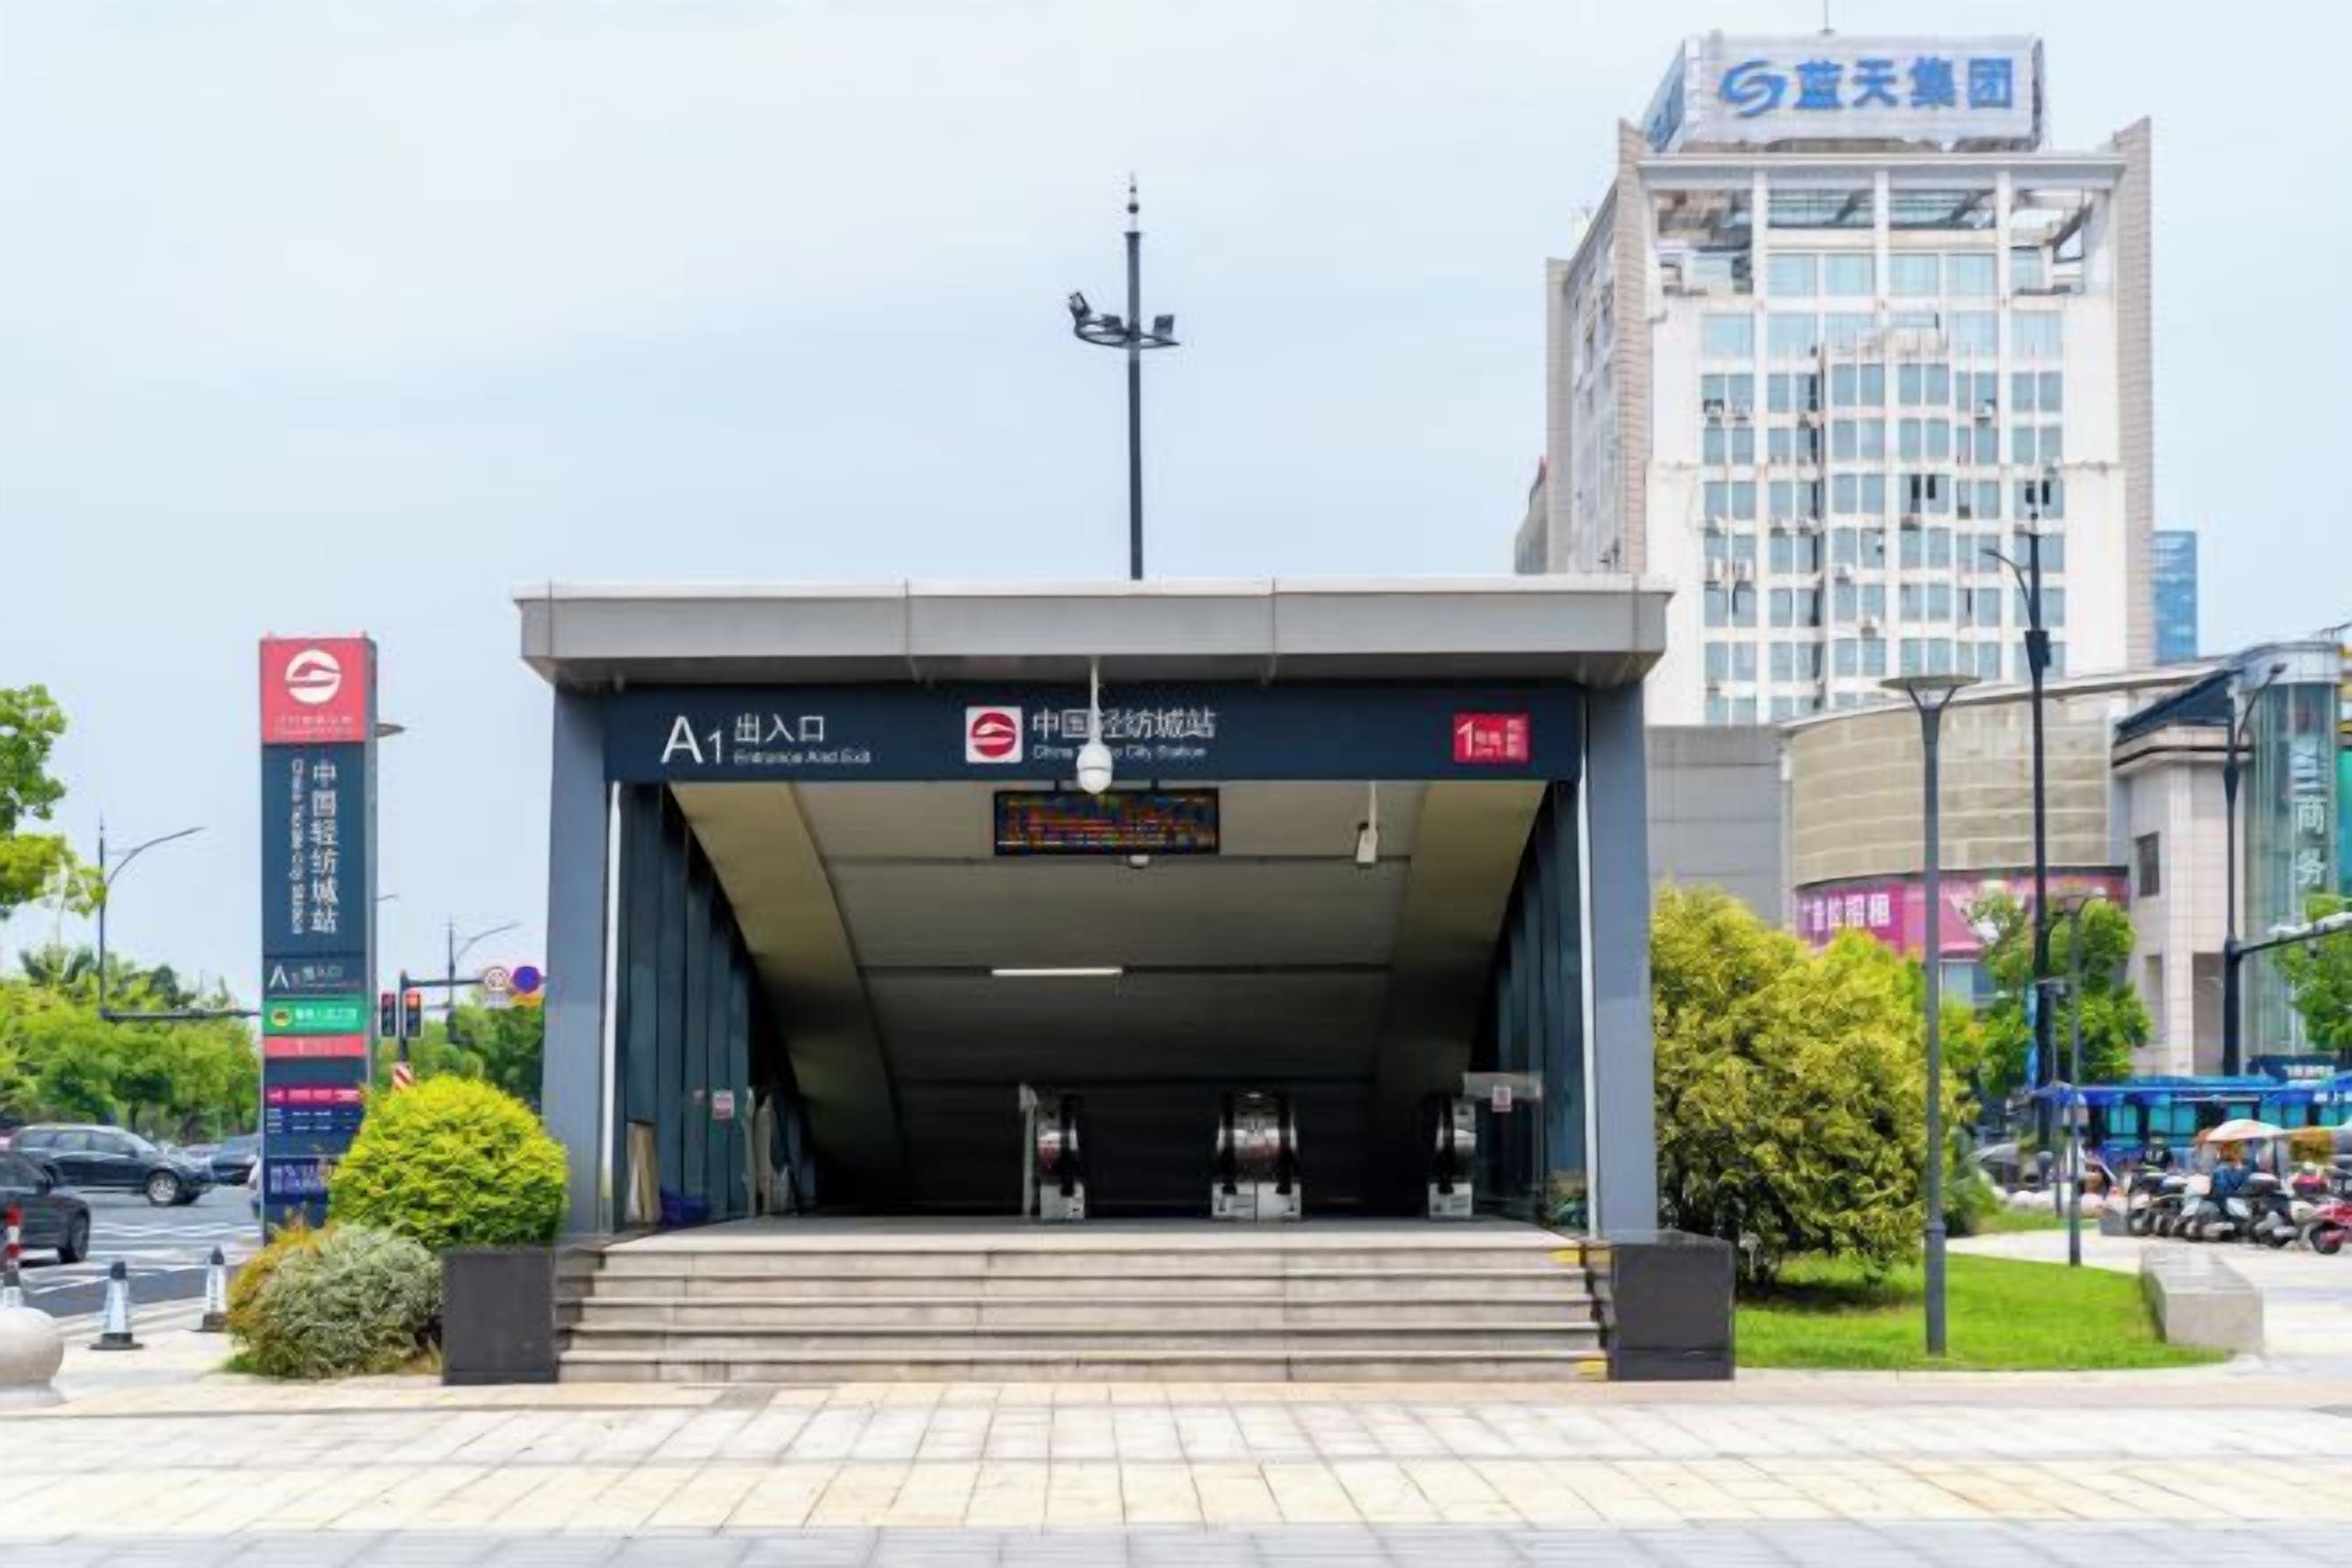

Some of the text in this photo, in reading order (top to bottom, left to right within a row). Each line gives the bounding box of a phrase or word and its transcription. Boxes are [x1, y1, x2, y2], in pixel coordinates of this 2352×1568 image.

[1795, 56, 2013, 110] 蓝天集团
[734, 713, 824, 743] 出入口
